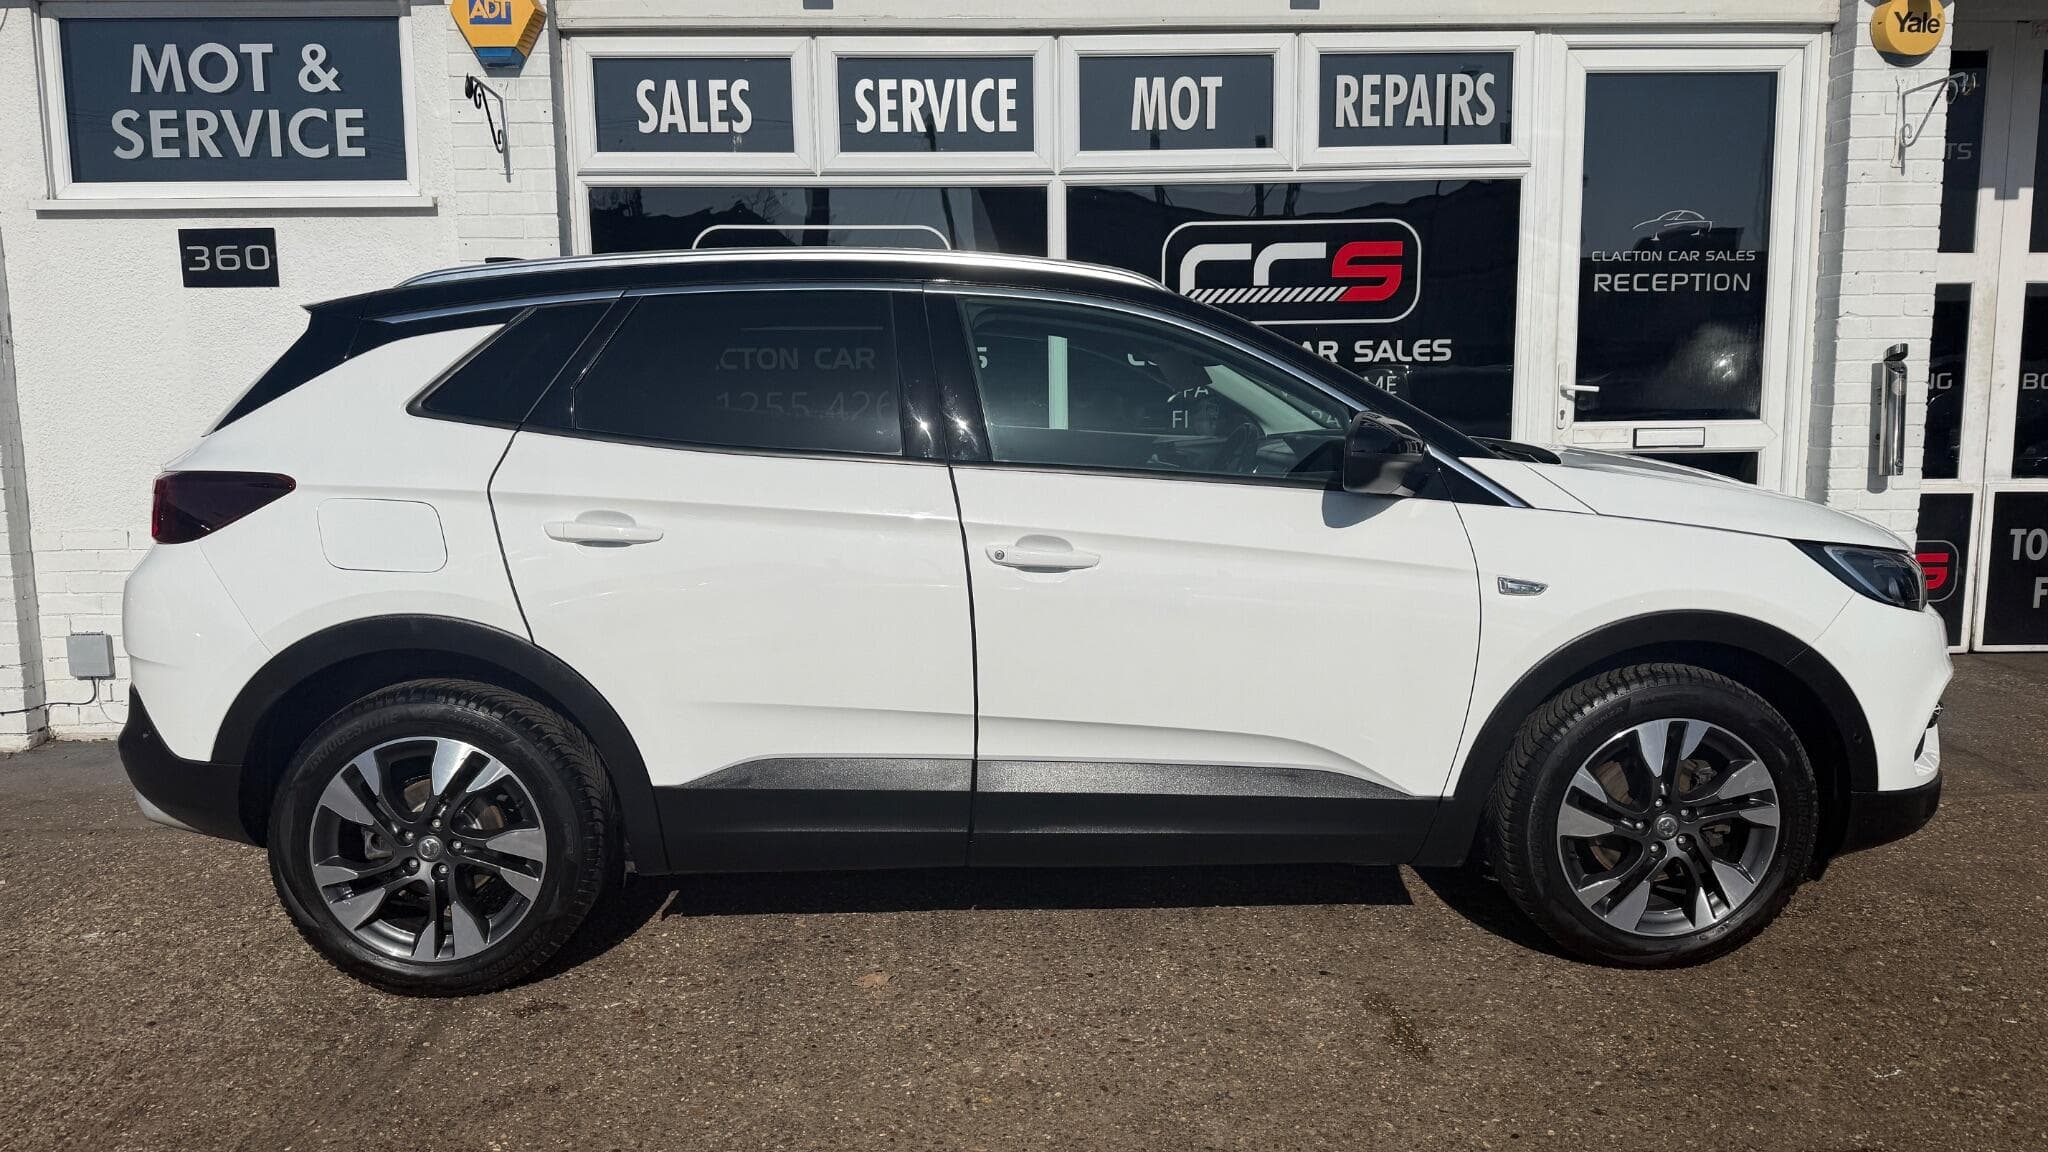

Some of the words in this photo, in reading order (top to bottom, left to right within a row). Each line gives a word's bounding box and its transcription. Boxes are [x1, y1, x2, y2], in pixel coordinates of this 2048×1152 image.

[470, 0, 511, 18] ADT
[1894, 11, 1940, 34] Yale
[130, 43, 273, 93] MOT
[298, 43, 341, 92] &
[636, 79, 752, 134] SALES
[855, 78, 1017, 133] SERVICE
[1131, 76, 1223, 131] MOT
[1335, 73, 1496, 128] REPAIRS
[111, 108, 366, 160] SERVICE
[186, 245, 271, 272] 360
[1179, 241, 1404, 303] CCS
[1591, 250, 1662, 262] CLACTON
[1668, 250, 1700, 262] CAR
[1705, 250, 1756, 262] SALES
[1593, 273, 1751, 292] RECEPTION
[814, 348, 876, 370] CAR
[1354, 338, 1452, 363] SALES
